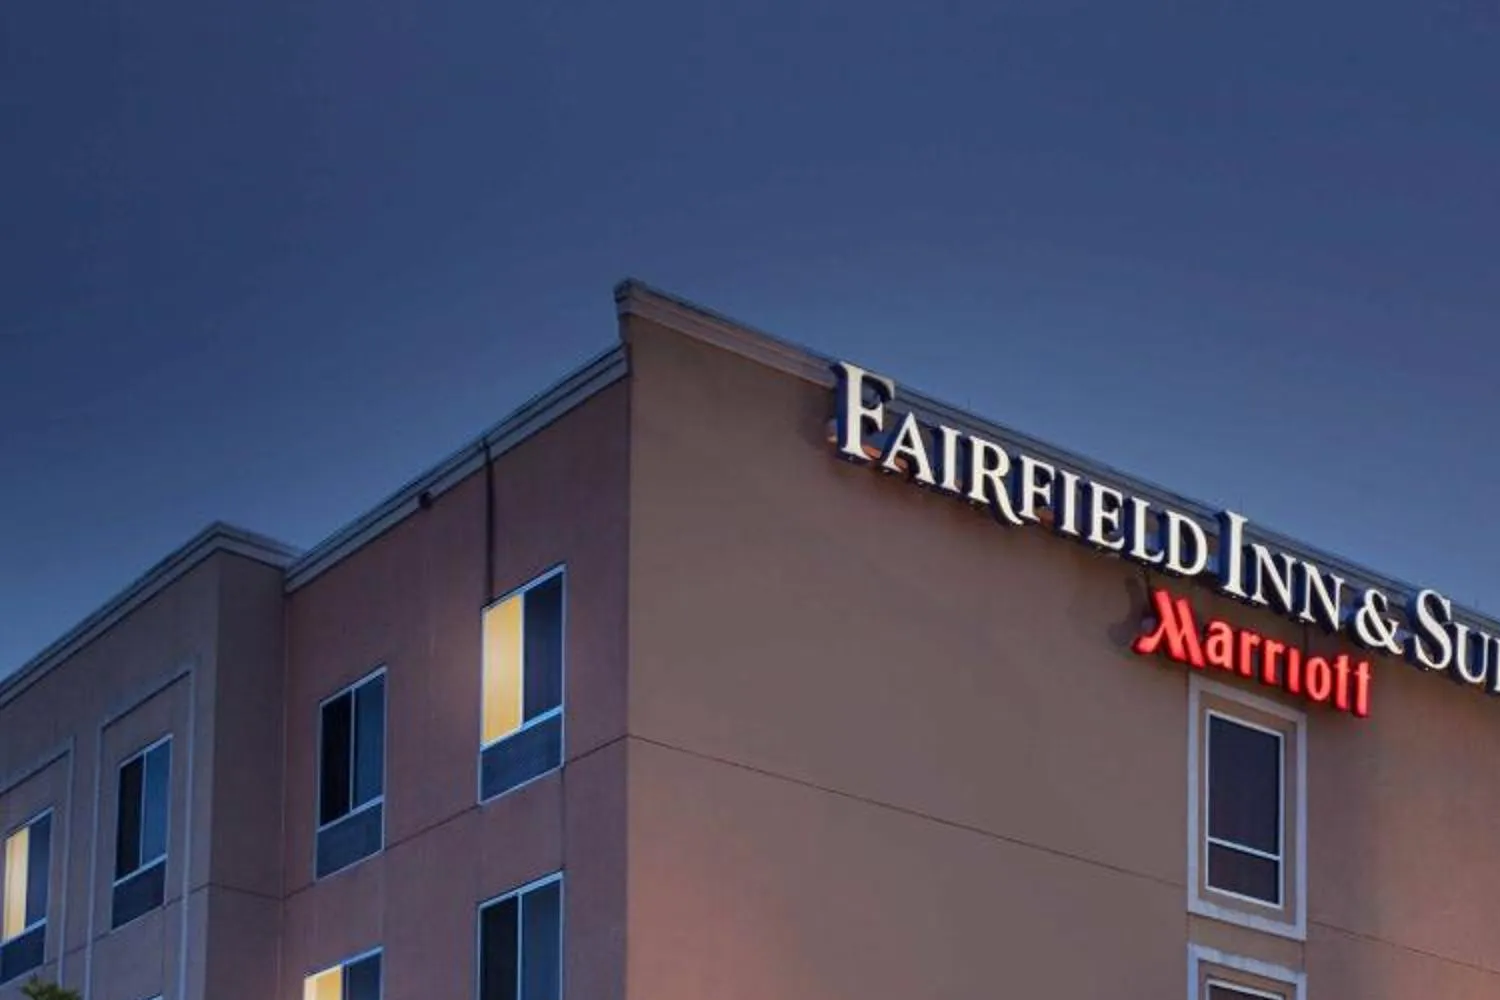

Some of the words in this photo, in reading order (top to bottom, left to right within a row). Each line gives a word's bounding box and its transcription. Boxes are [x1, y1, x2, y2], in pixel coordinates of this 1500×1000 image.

[838, 362, 1208, 576] FAIRFIELD
[1217, 511, 1346, 631] INN
[1354, 589, 1403, 656] &
[1134, 588, 1372, 718] Marriott
